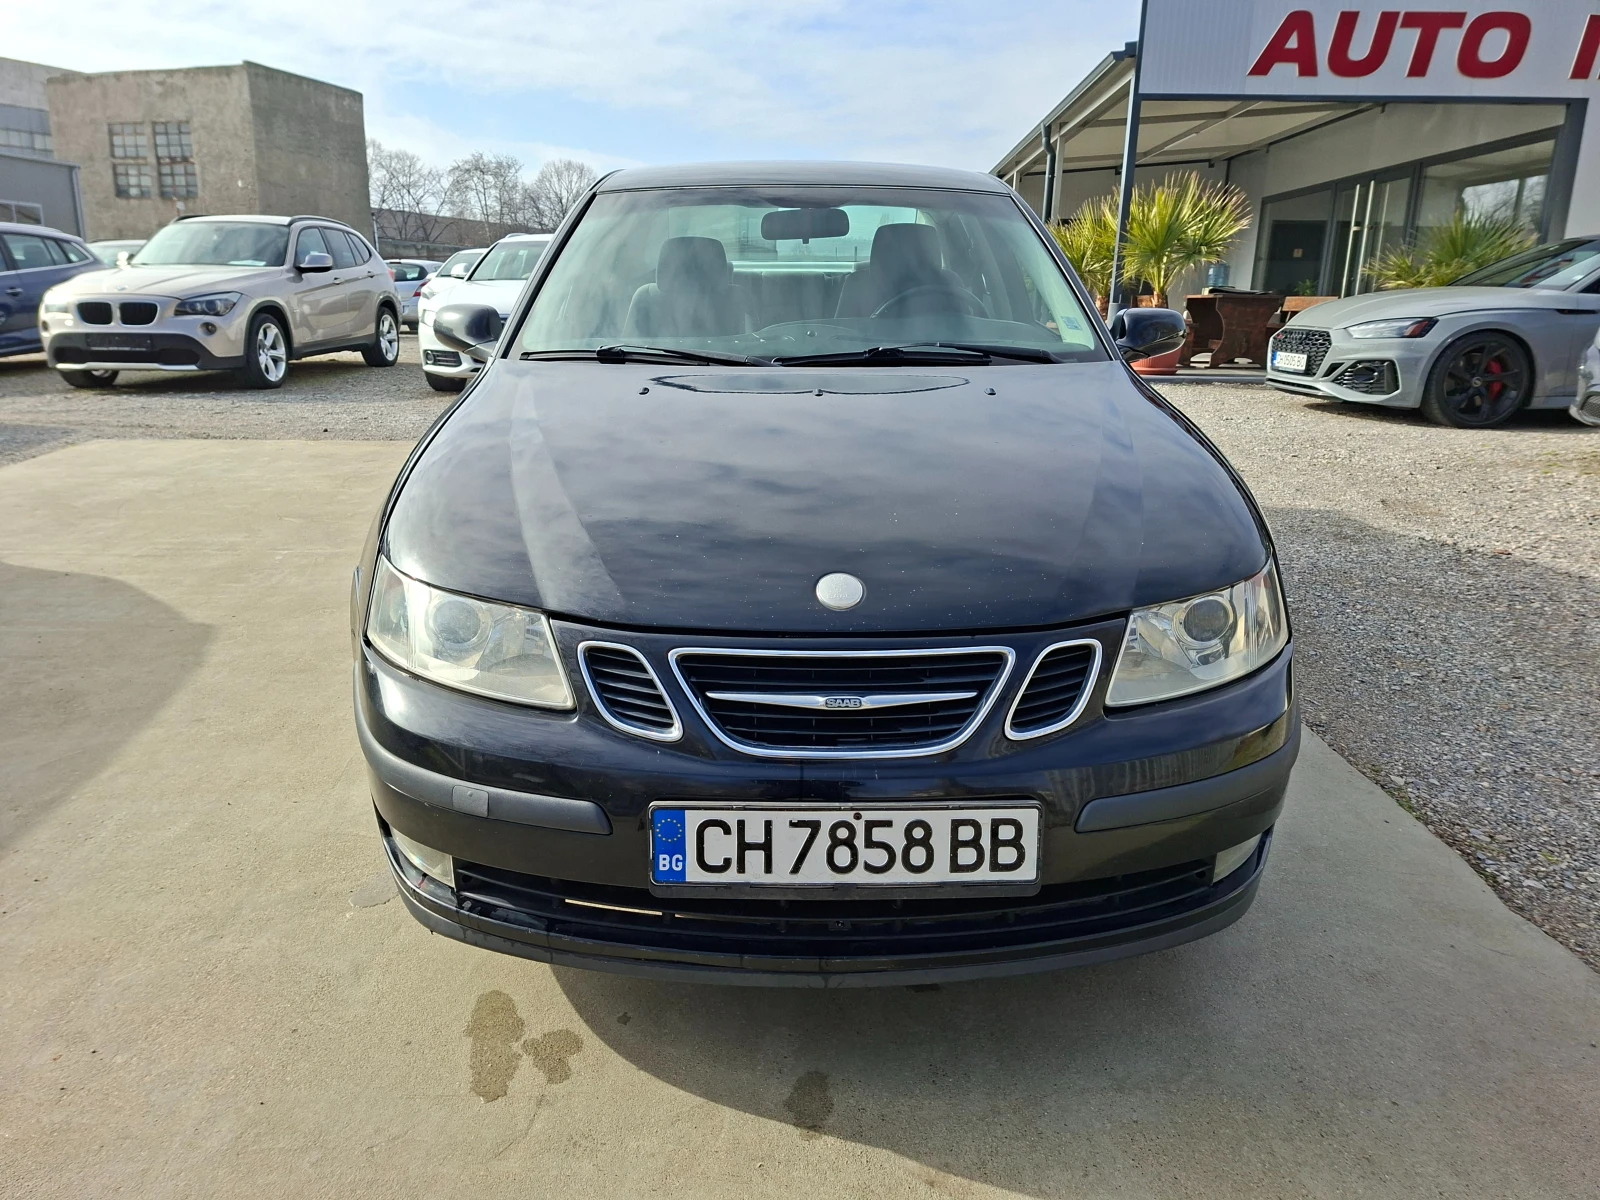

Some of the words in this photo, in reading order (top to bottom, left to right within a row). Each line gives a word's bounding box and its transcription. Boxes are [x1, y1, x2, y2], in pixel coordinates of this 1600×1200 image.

[1246, 10, 1532, 79] AUTO
[826, 699, 860, 708] SAAB
[658, 854, 683, 871] BG
[695, 818, 773, 874] CH
[788, 818, 935, 875] 7858
[949, 818, 1025, 874] BB
